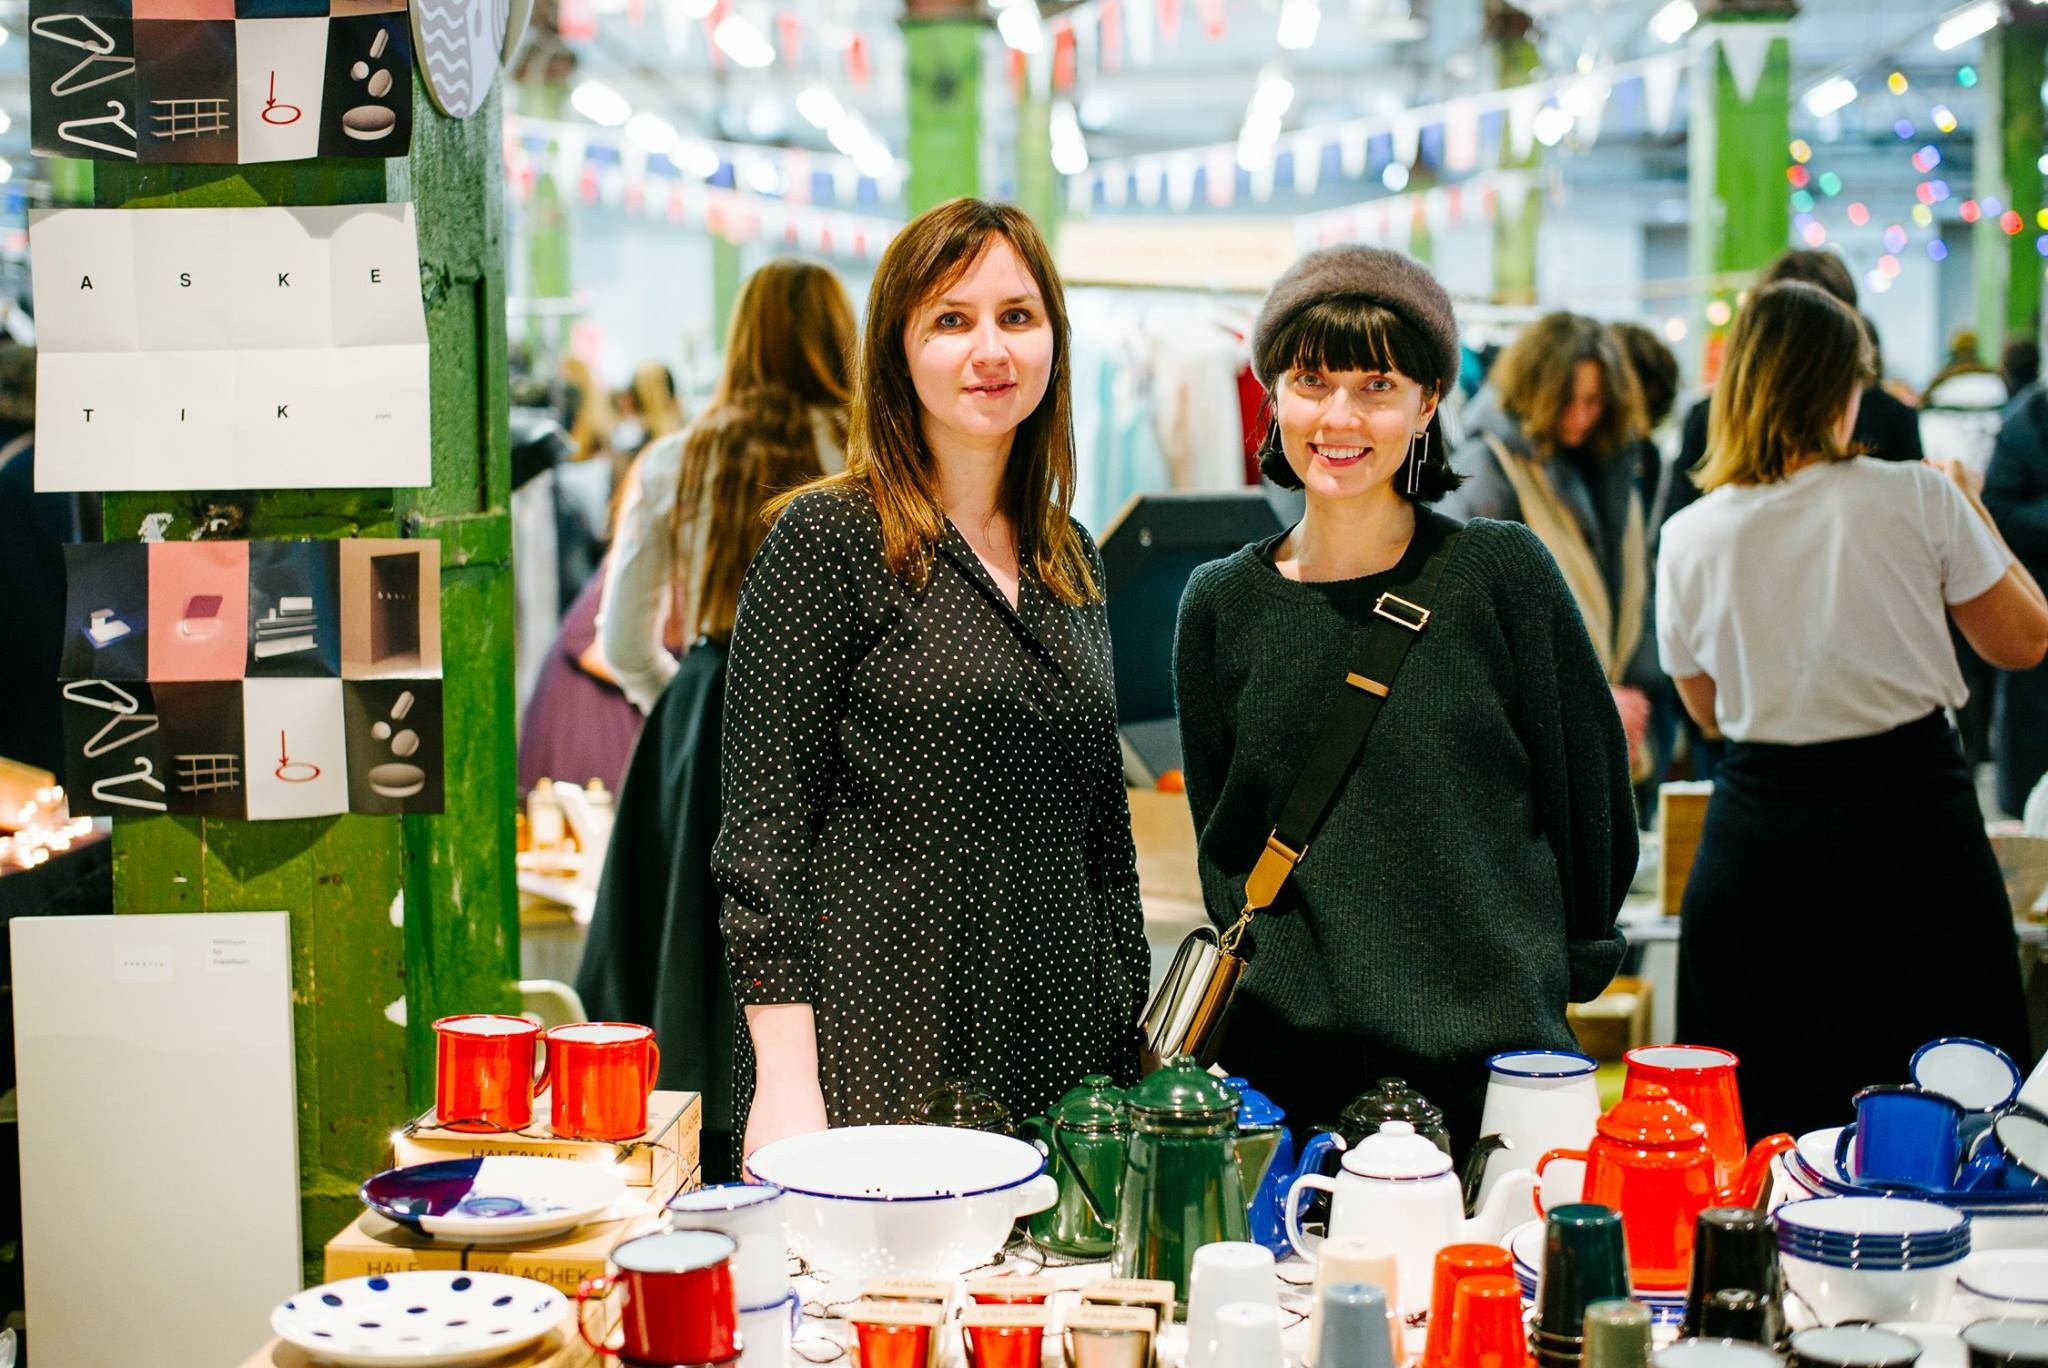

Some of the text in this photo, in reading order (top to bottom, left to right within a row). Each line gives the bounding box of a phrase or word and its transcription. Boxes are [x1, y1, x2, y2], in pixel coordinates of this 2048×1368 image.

[80, 269, 381, 290] A S K E
[83, 408, 94, 423] T
[277, 405, 288, 418] K
